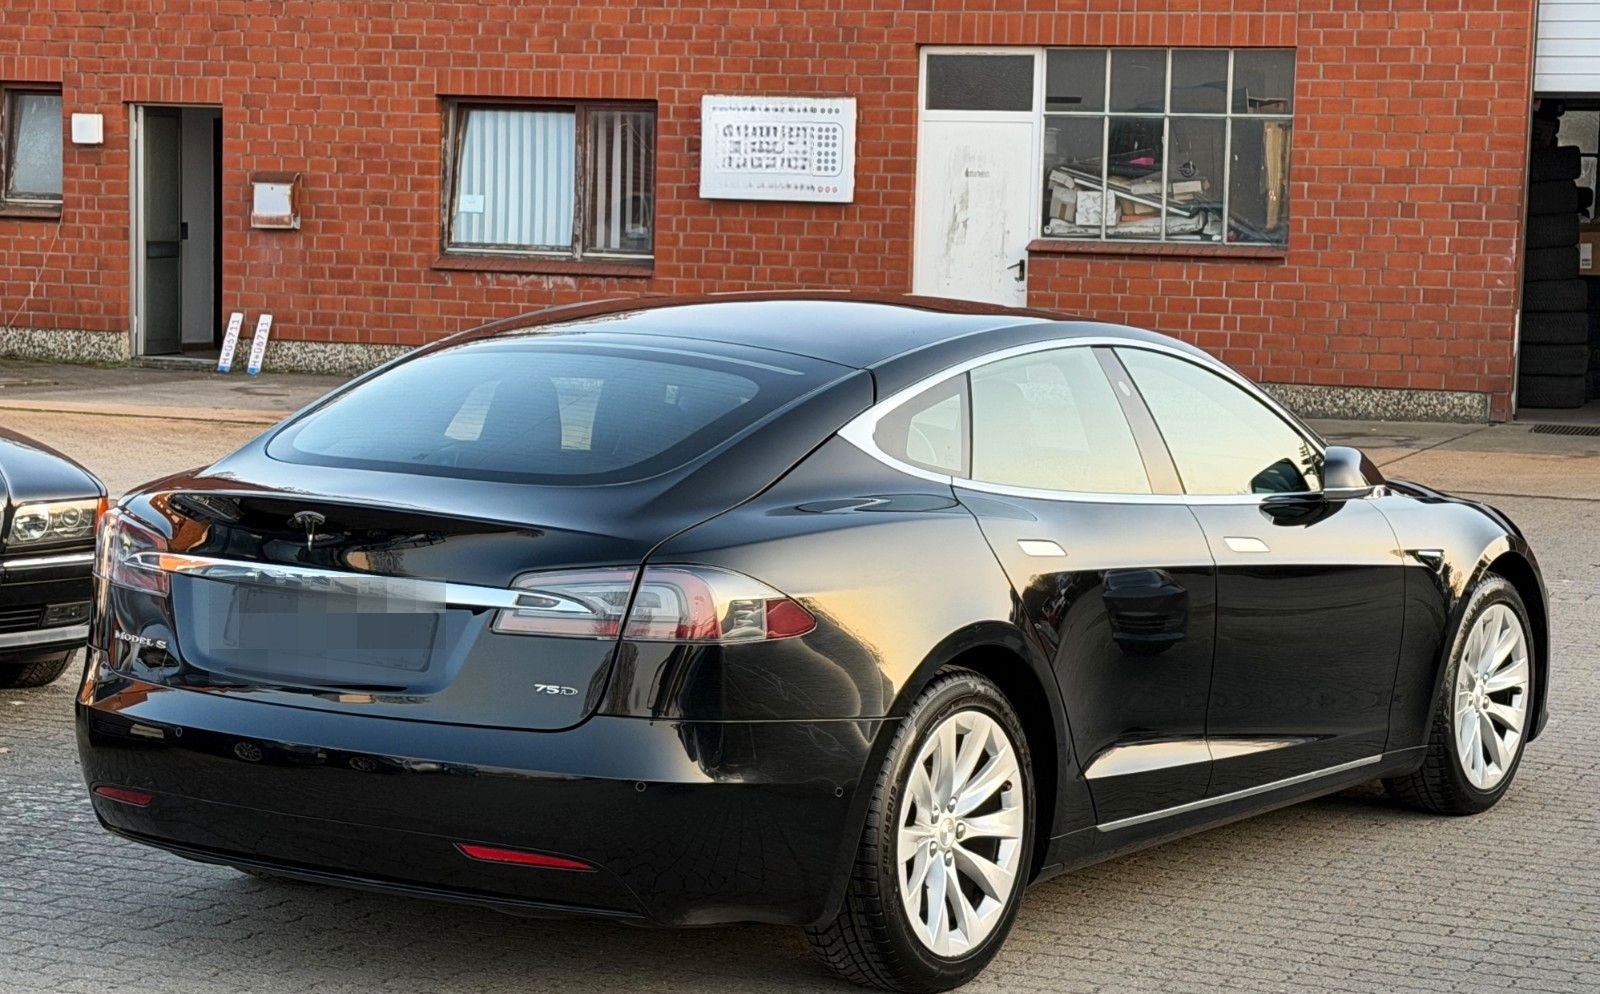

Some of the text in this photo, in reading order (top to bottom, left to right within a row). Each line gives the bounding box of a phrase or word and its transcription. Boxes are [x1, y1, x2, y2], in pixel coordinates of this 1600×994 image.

[115, 630, 167, 649] MODEL S
[534, 683, 579, 696] 75D
